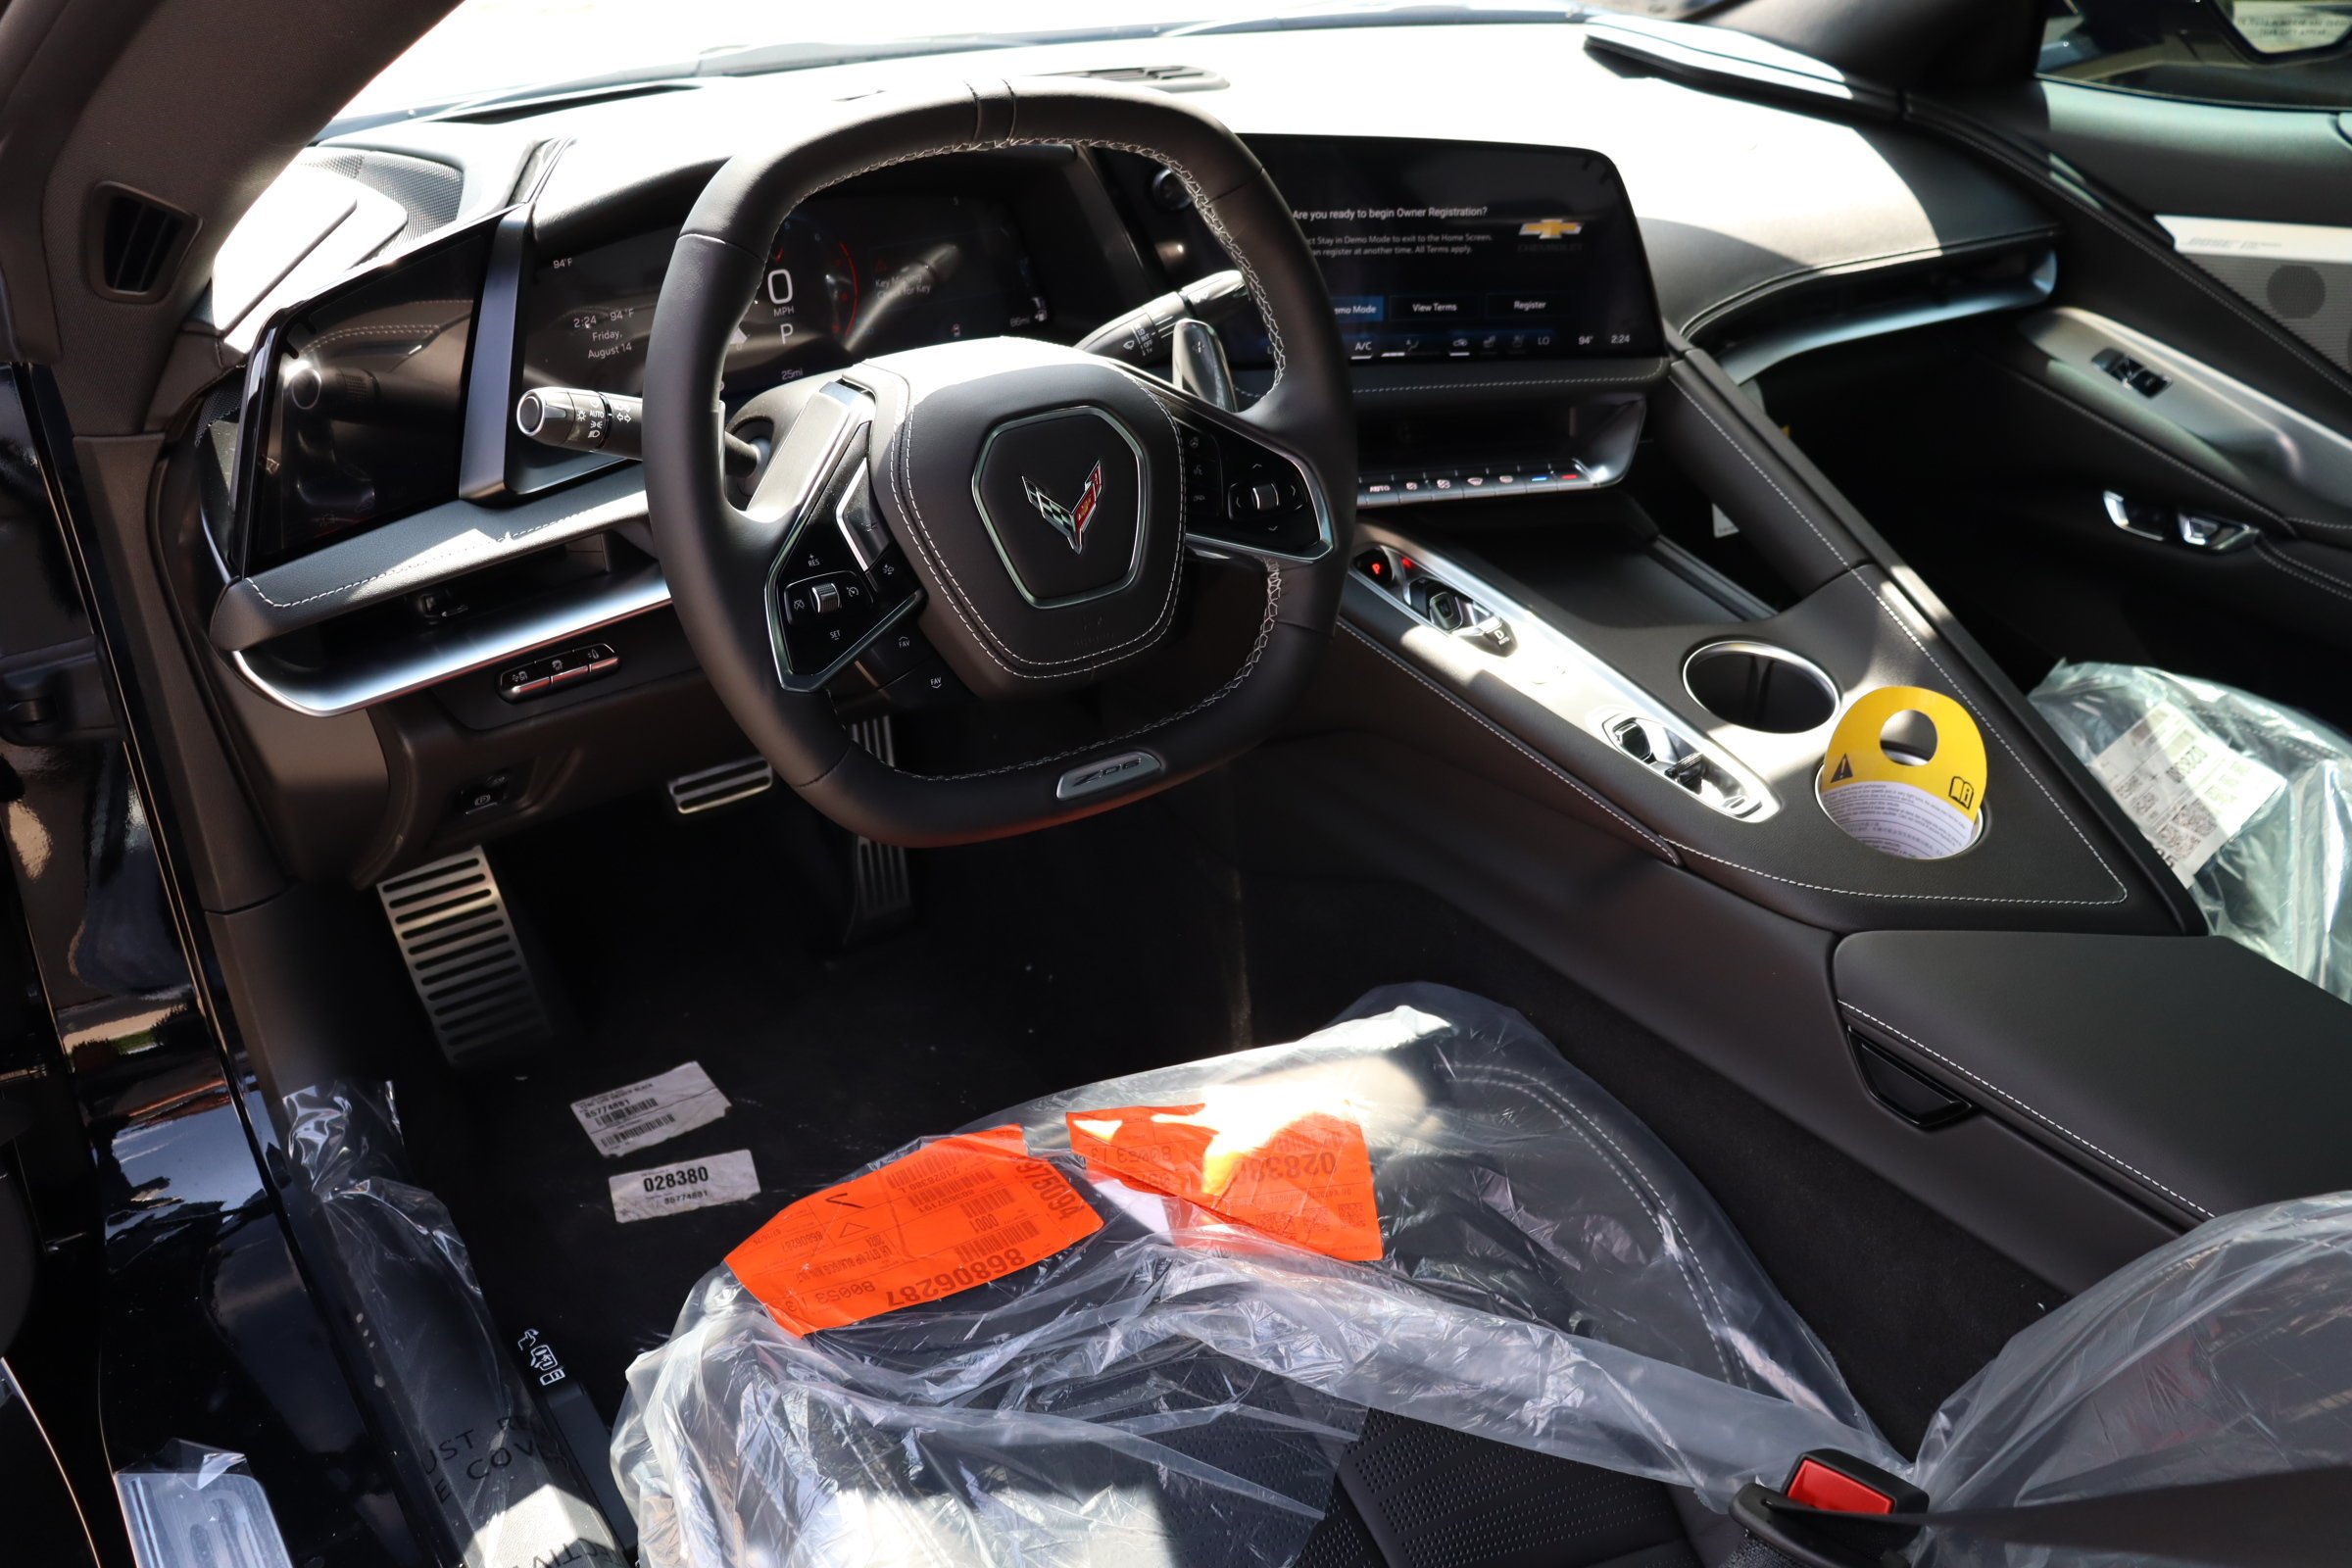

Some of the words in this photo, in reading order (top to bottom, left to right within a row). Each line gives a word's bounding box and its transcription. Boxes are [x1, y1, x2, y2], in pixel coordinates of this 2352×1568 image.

[1293, 210, 1311, 220] Are
[1310, 210, 1328, 221] you
[1329, 208, 1355, 220] ready
[1356, 209, 1367, 219] to
[1368, 208, 1395, 220] begin
[1396, 207, 1426, 218] Owner
[1428, 206, 1488, 220] Registration?
[1316, 235, 1334, 247] Stay
[1368, 235, 1391, 244] Mode
[1401, 234, 1416, 243] exit
[1427, 233, 1440, 242] the
[1441, 233, 1464, 242] Home
[1322, 248, 1352, 258] register
[1414, 245, 1426, 254] All
[1427, 245, 1449, 254] Terms
[767, 269, 794, 305] 0
[773, 306, 795, 318] MPH
[1334, 306, 1351, 315] emo
[1352, 305, 1377, 314] Mode
[1412, 303, 1432, 313] View
[1433, 302, 1458, 312] Terms
[1513, 300, 1546, 312] Register
[592, 330, 623, 342] Friday,
[780, 322, 794, 345] P
[1354, 341, 1372, 351] A/C
[1537, 336, 1550, 346] LO
[588, 346, 620, 360] August
[620, 342, 632, 353] 14
[589, 410, 605, 418] AUTO
[807, 558, 820, 567] RES
[1371, 563, 1381, 575] P
[829, 629, 841, 639] SET
[899, 639, 910, 649] FAV
[930, 676, 942, 685] FAV
[643, 1165, 710, 1194] 028380
[969, 1213, 1000, 1234] 0001
[885, 1248, 1026, 1307] 86806287
[814, 1281, 876, 1304] 80053
